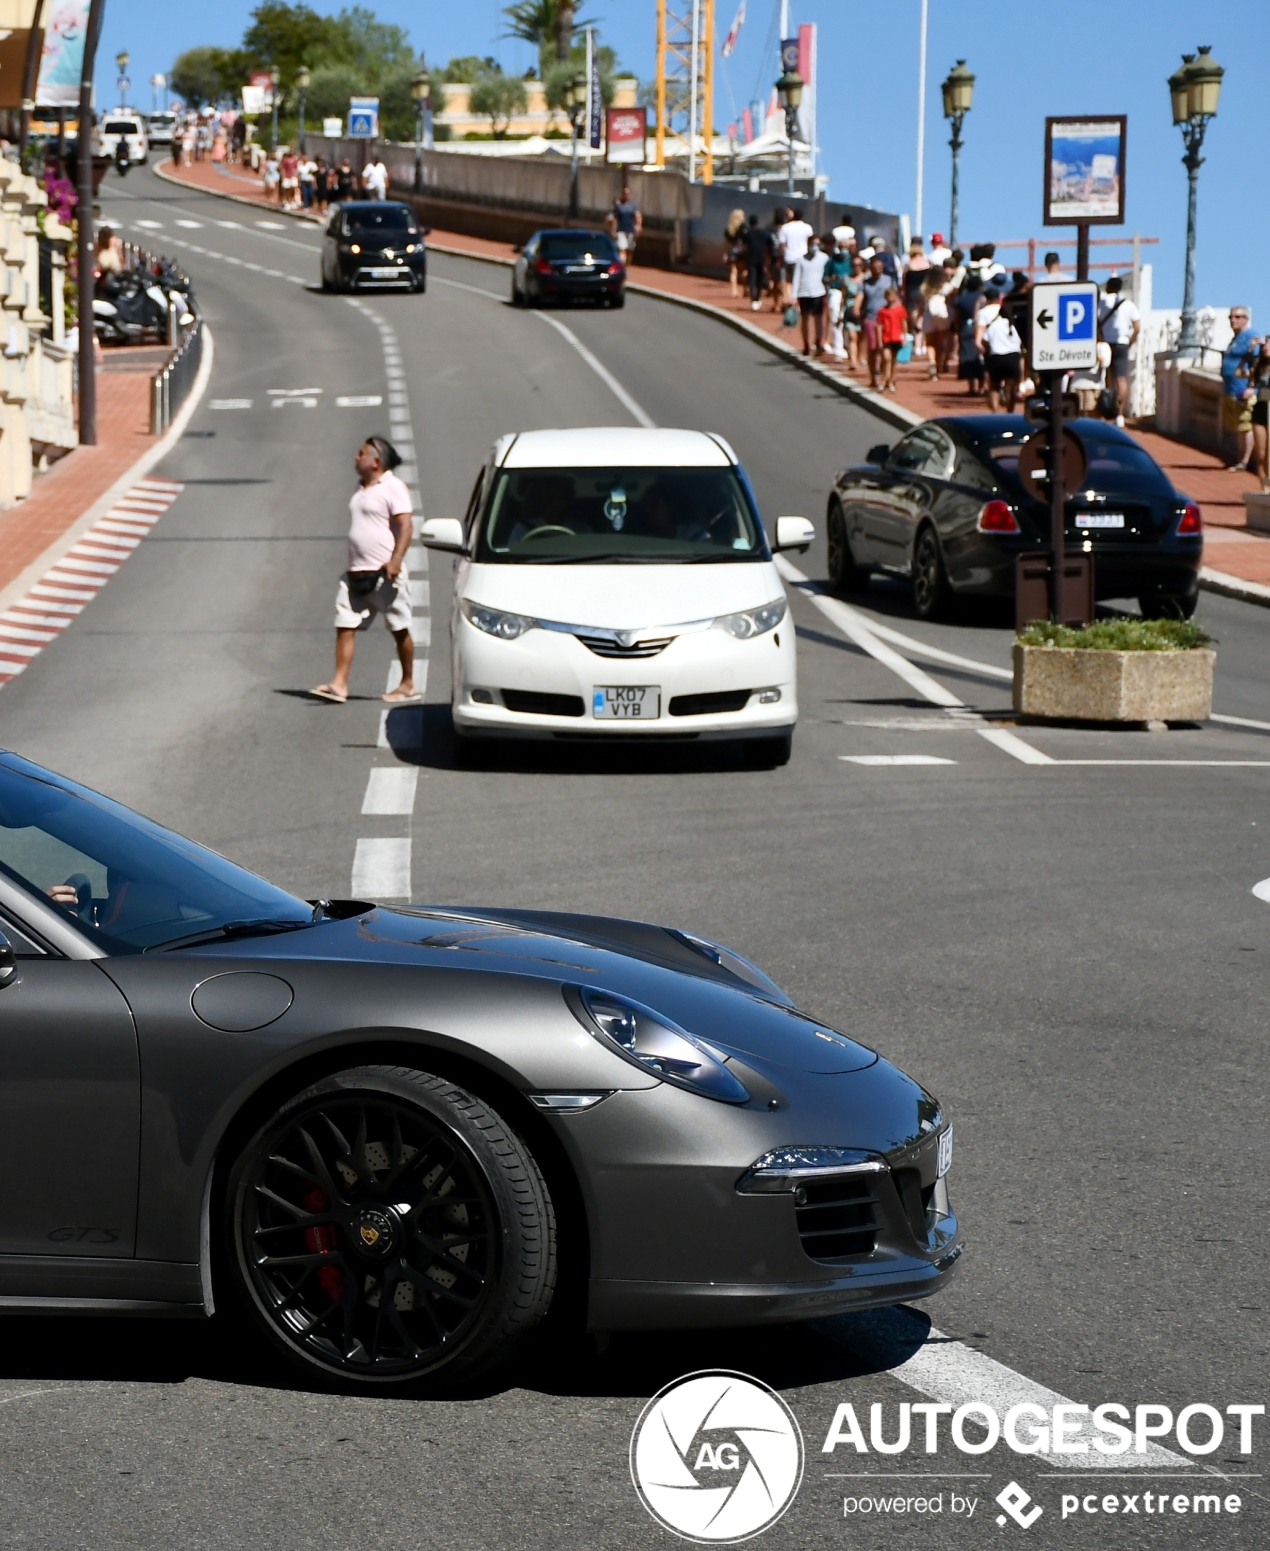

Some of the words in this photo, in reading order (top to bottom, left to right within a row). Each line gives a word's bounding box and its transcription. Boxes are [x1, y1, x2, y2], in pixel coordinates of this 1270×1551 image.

[1066, 300, 1085, 334] P
[1059, 348, 1092, 361] Dévote
[605, 687, 646, 702] LK07
[611, 703, 641, 716] VYB
[47, 1225, 121, 1243] GTS
